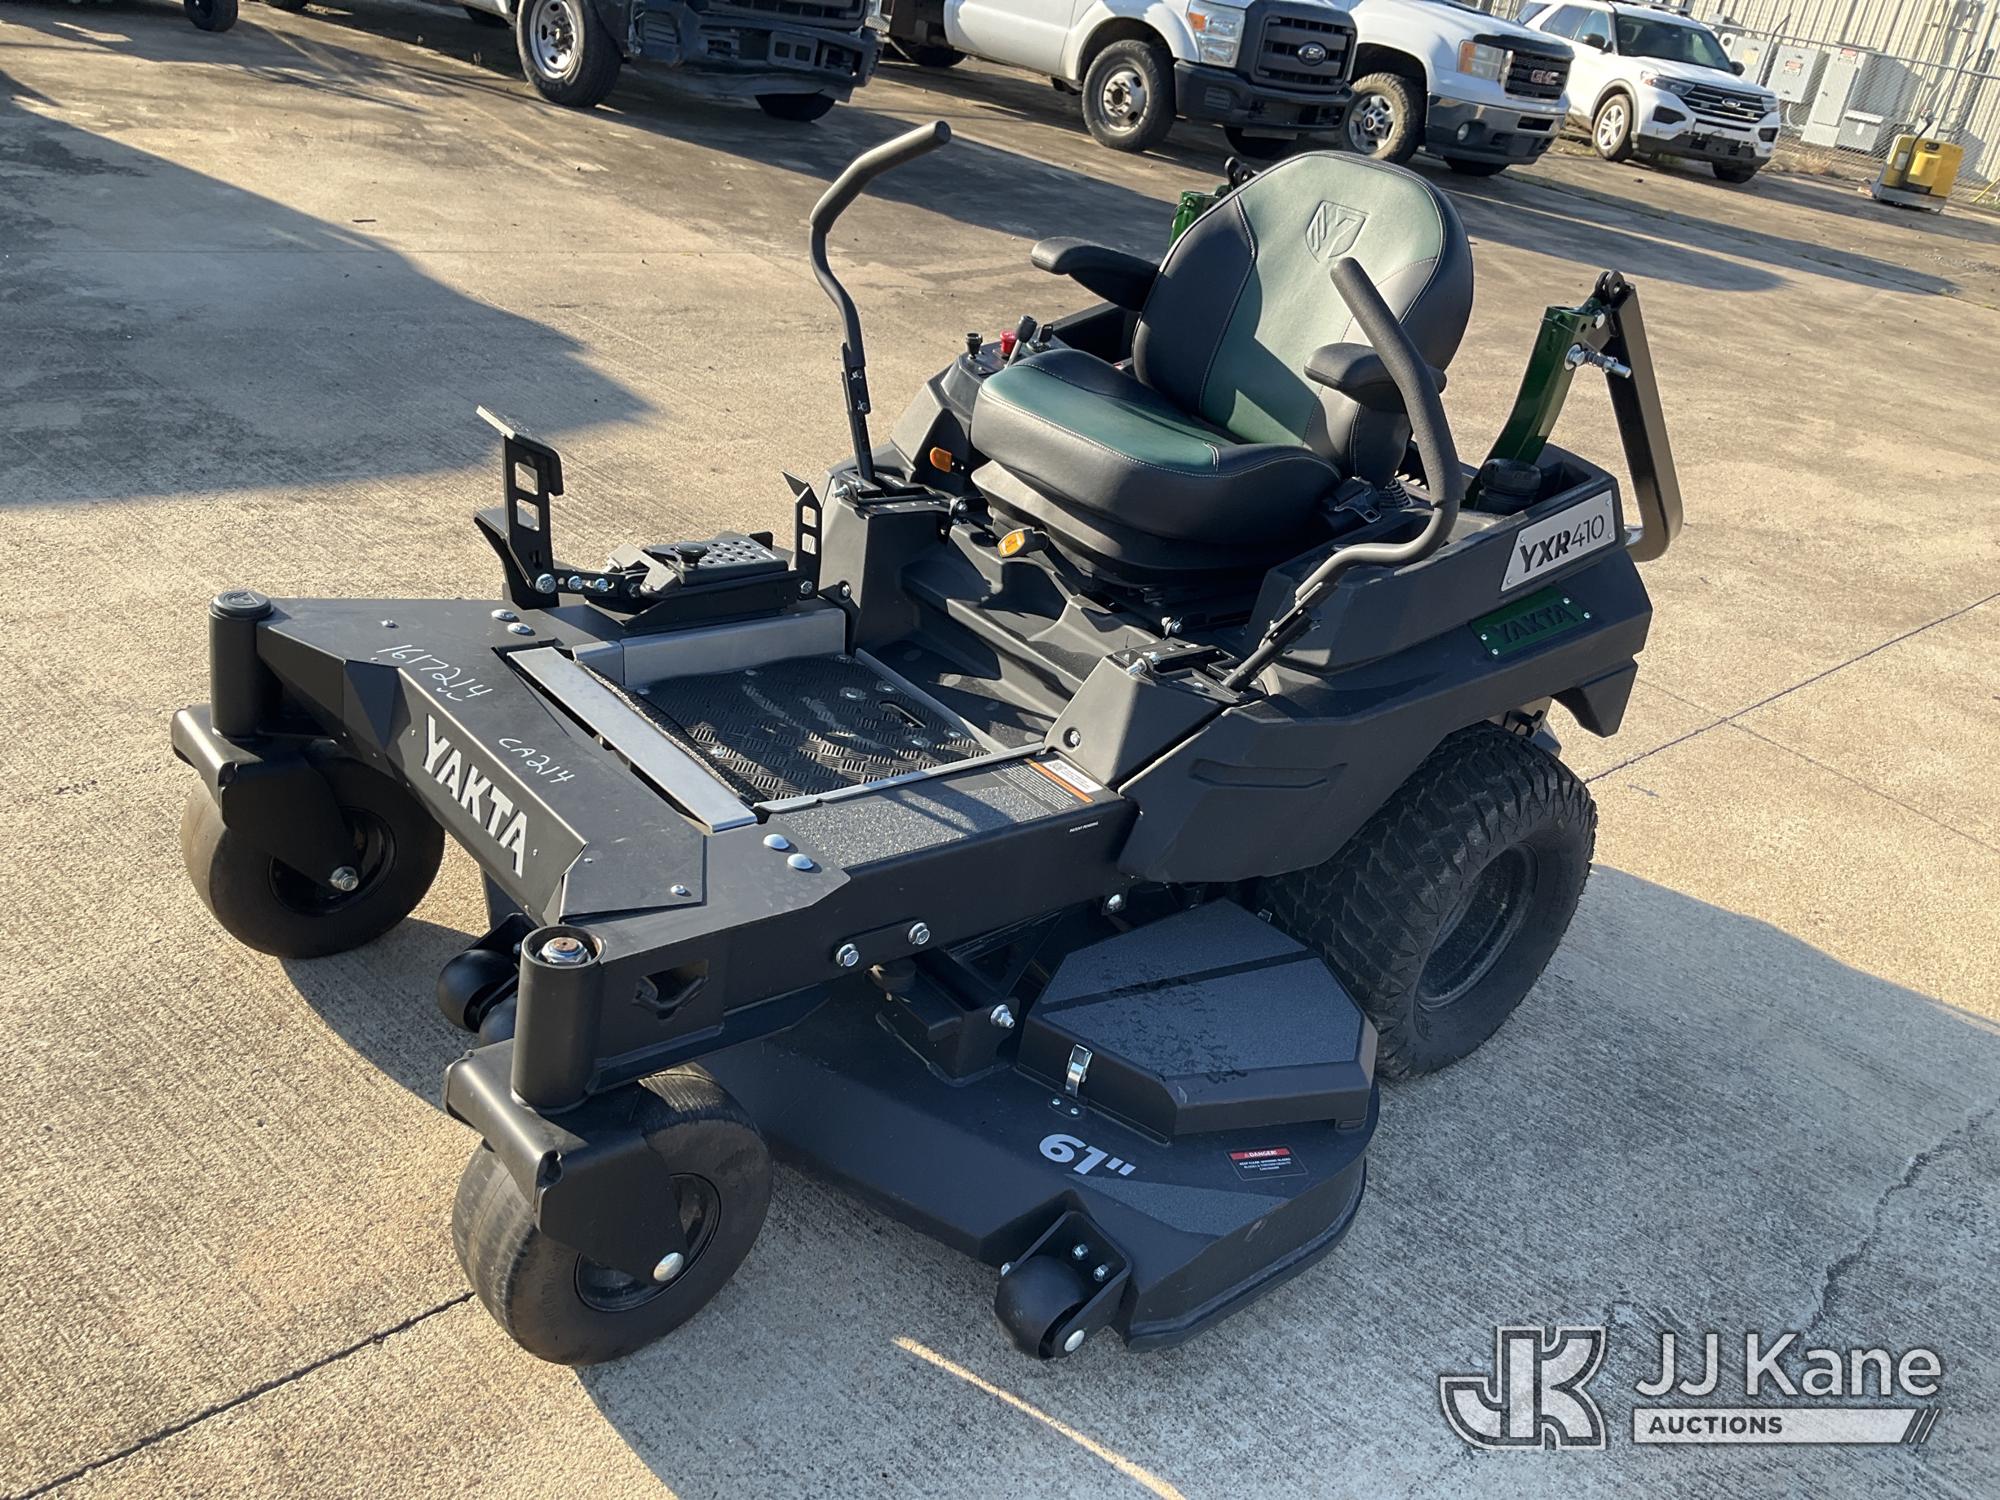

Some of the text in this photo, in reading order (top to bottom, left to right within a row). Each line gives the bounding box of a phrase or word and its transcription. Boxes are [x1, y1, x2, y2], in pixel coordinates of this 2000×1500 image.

[1519, 514, 1605, 574] YXR410
[1490, 604, 1579, 645] YAKTA
[376, 644, 494, 699] 1617214
[498, 738, 576, 783] CA214
[423, 713, 528, 879] YAKTA
[1039, 1133, 1137, 1176] 61"
